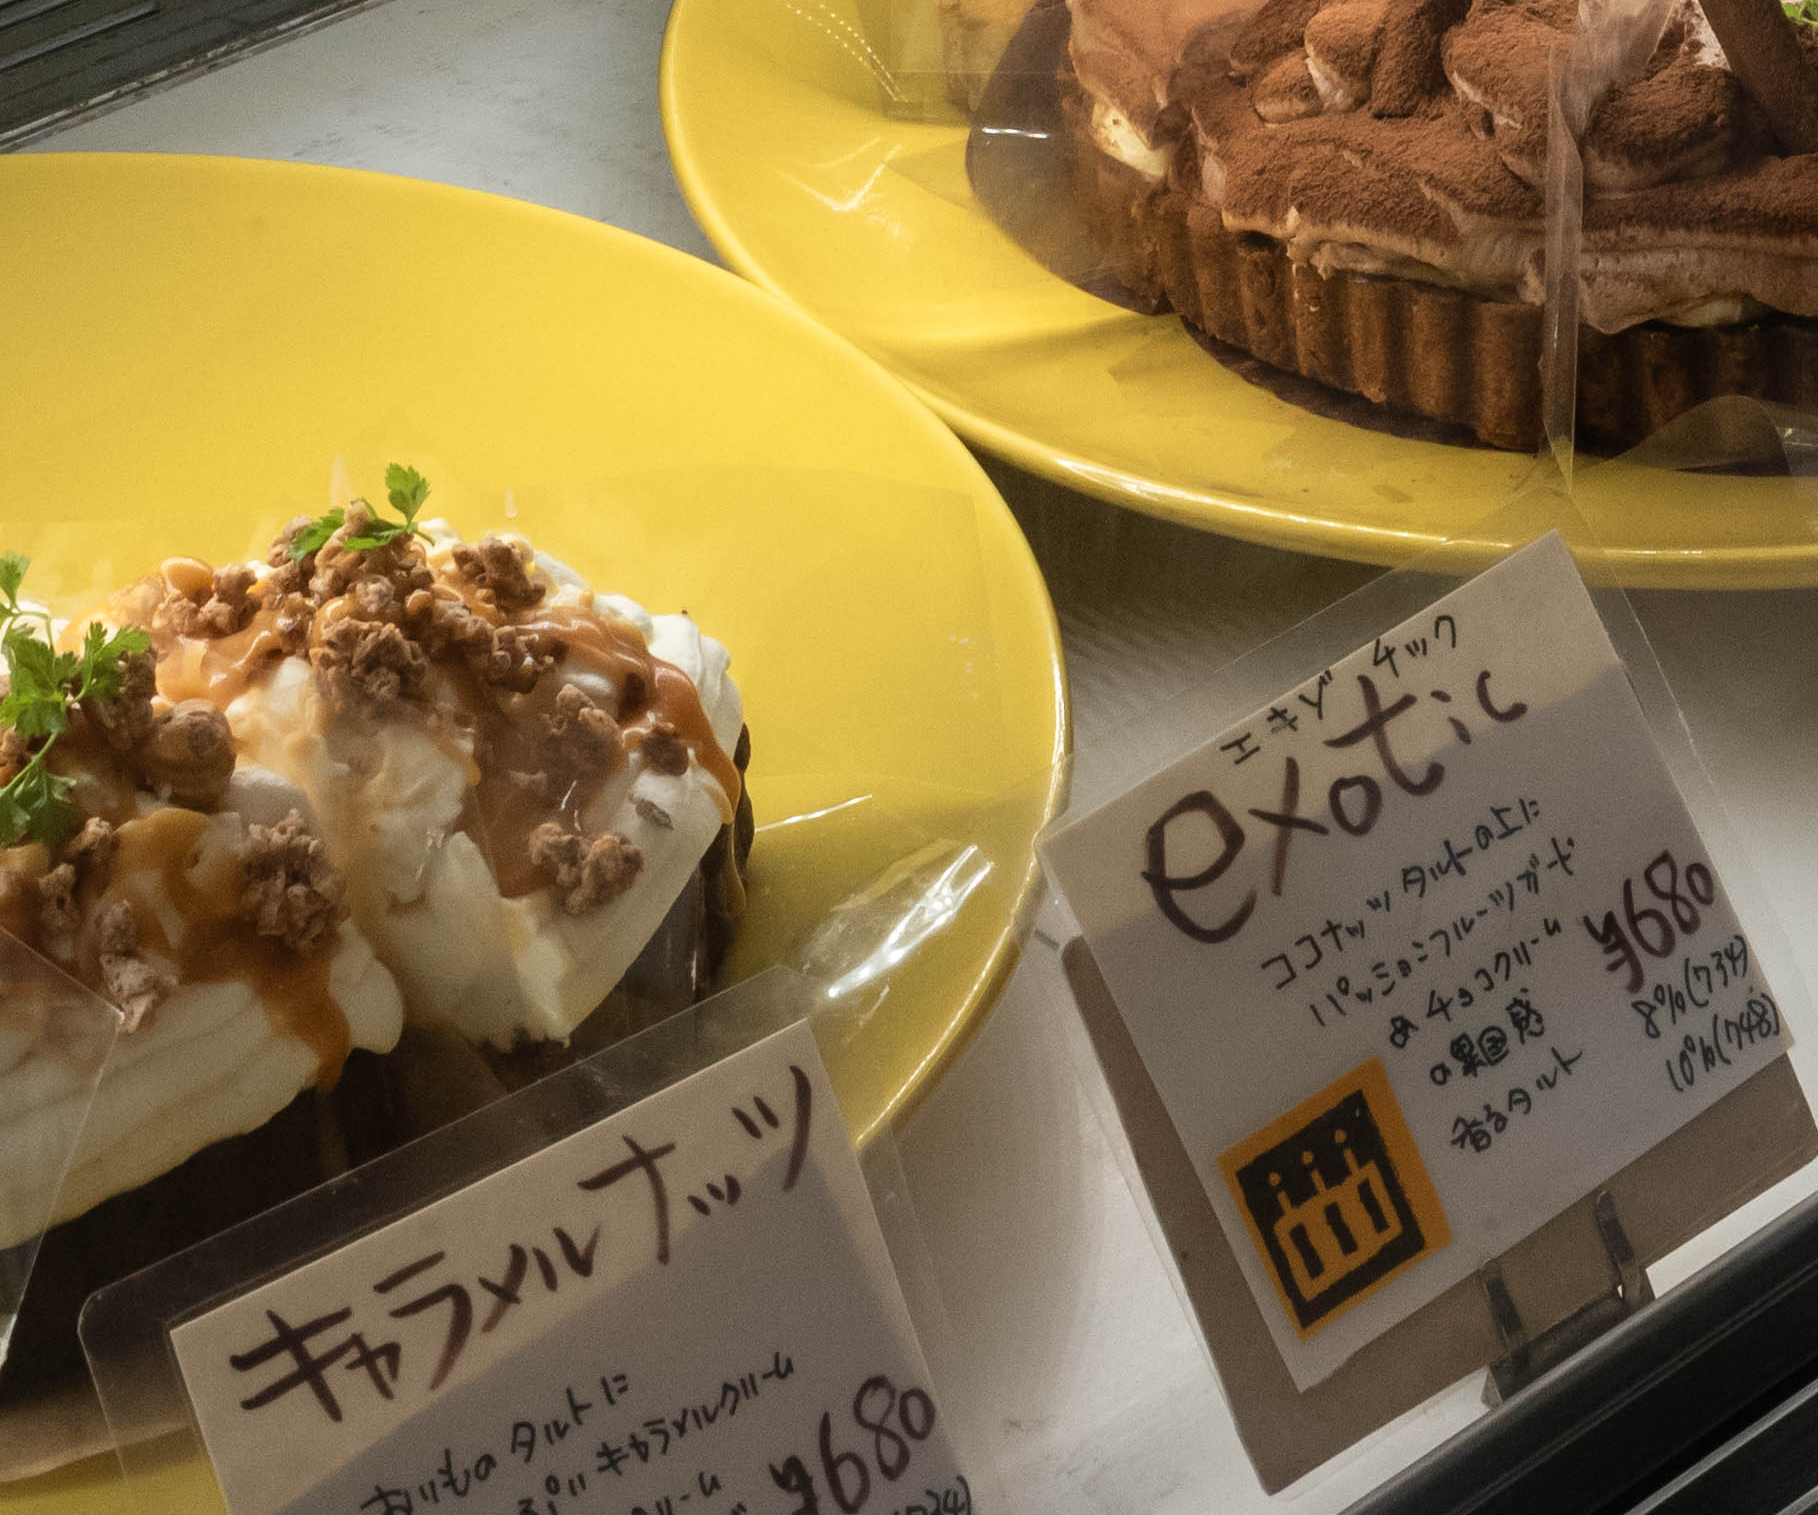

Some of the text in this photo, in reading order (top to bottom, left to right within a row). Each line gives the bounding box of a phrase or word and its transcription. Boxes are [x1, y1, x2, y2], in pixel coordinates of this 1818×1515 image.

[1141, 670, 1529, 945] exotic
[1583, 851, 1716, 993] ¥680
[1631, 933, 1749, 1040] 8%(734)
[230, 1063, 813, 1422] キャラメルナッツ
